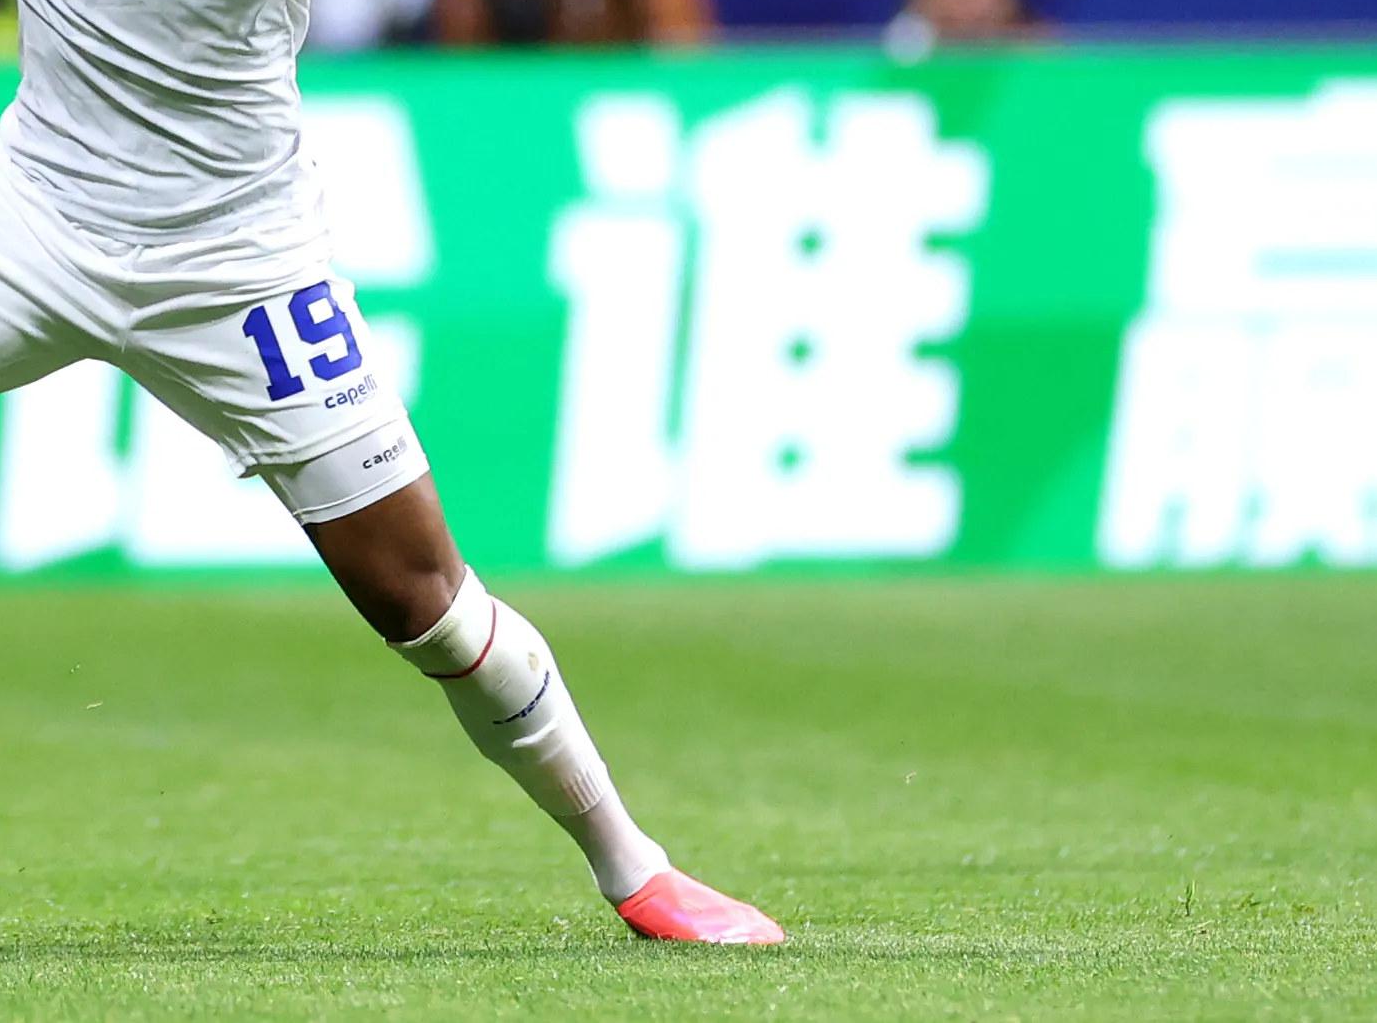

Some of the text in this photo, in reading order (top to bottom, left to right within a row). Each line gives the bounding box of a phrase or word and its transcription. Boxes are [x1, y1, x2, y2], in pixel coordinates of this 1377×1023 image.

[242, 280, 363, 402] 19
[324, 374, 378, 409] capelli
[363, 436, 407, 469] capelli
